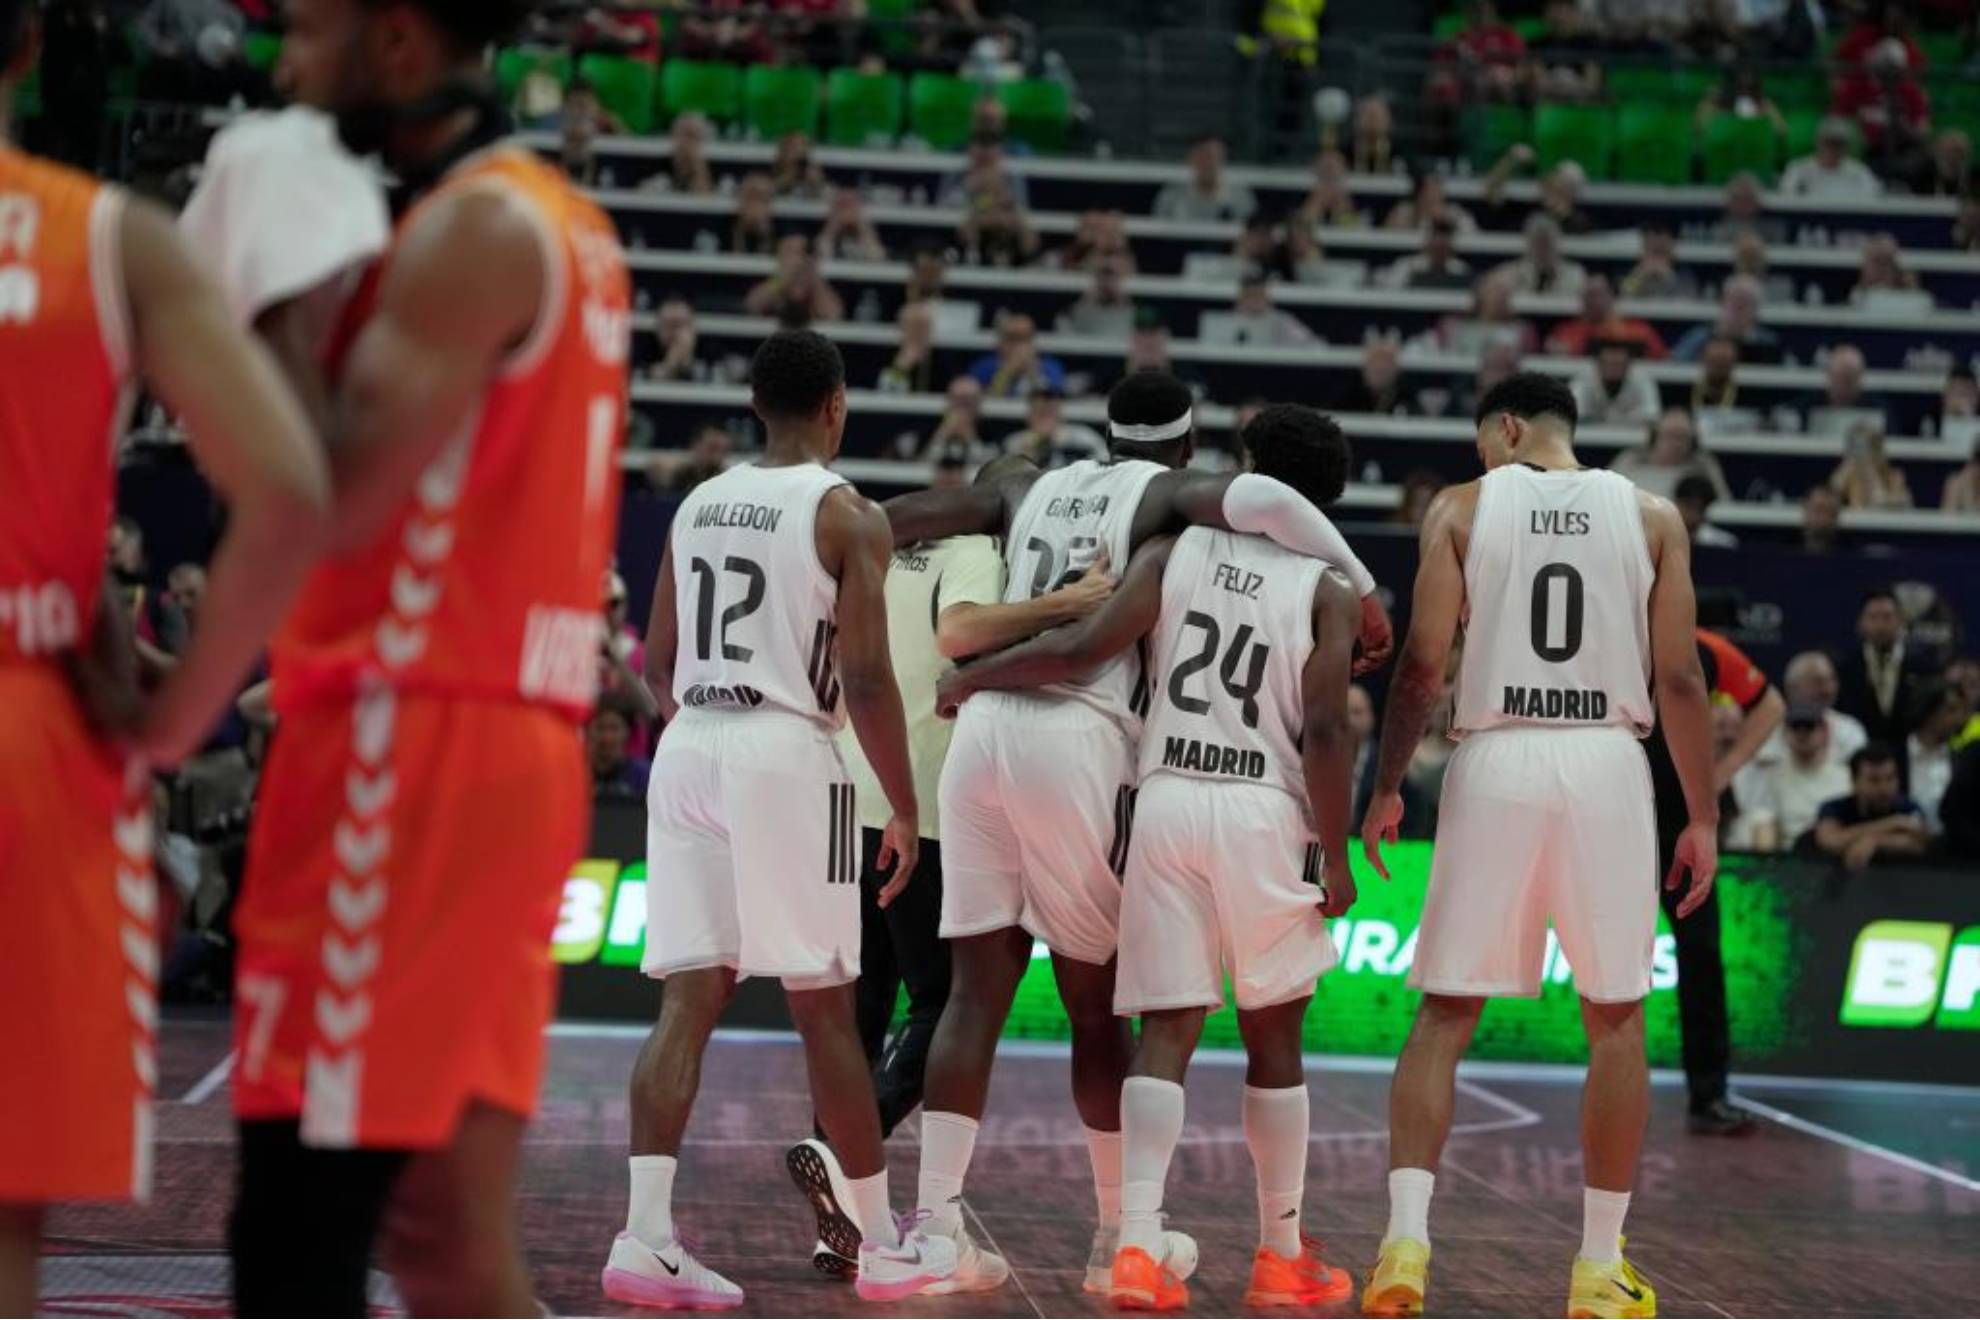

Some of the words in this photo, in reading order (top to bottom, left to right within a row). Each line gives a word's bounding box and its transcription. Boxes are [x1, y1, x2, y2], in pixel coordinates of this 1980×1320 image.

[693, 503, 782, 533] MALEDON
[1531, 510, 1590, 535] LYLES
[1212, 563, 1265, 600] FELIZ
[691, 555, 766, 664] 12
[1531, 562, 1584, 663] 0
[1167, 610, 1270, 729] 24
[1503, 686, 1608, 720] MADRID
[1162, 736, 1266, 779] MADRID
